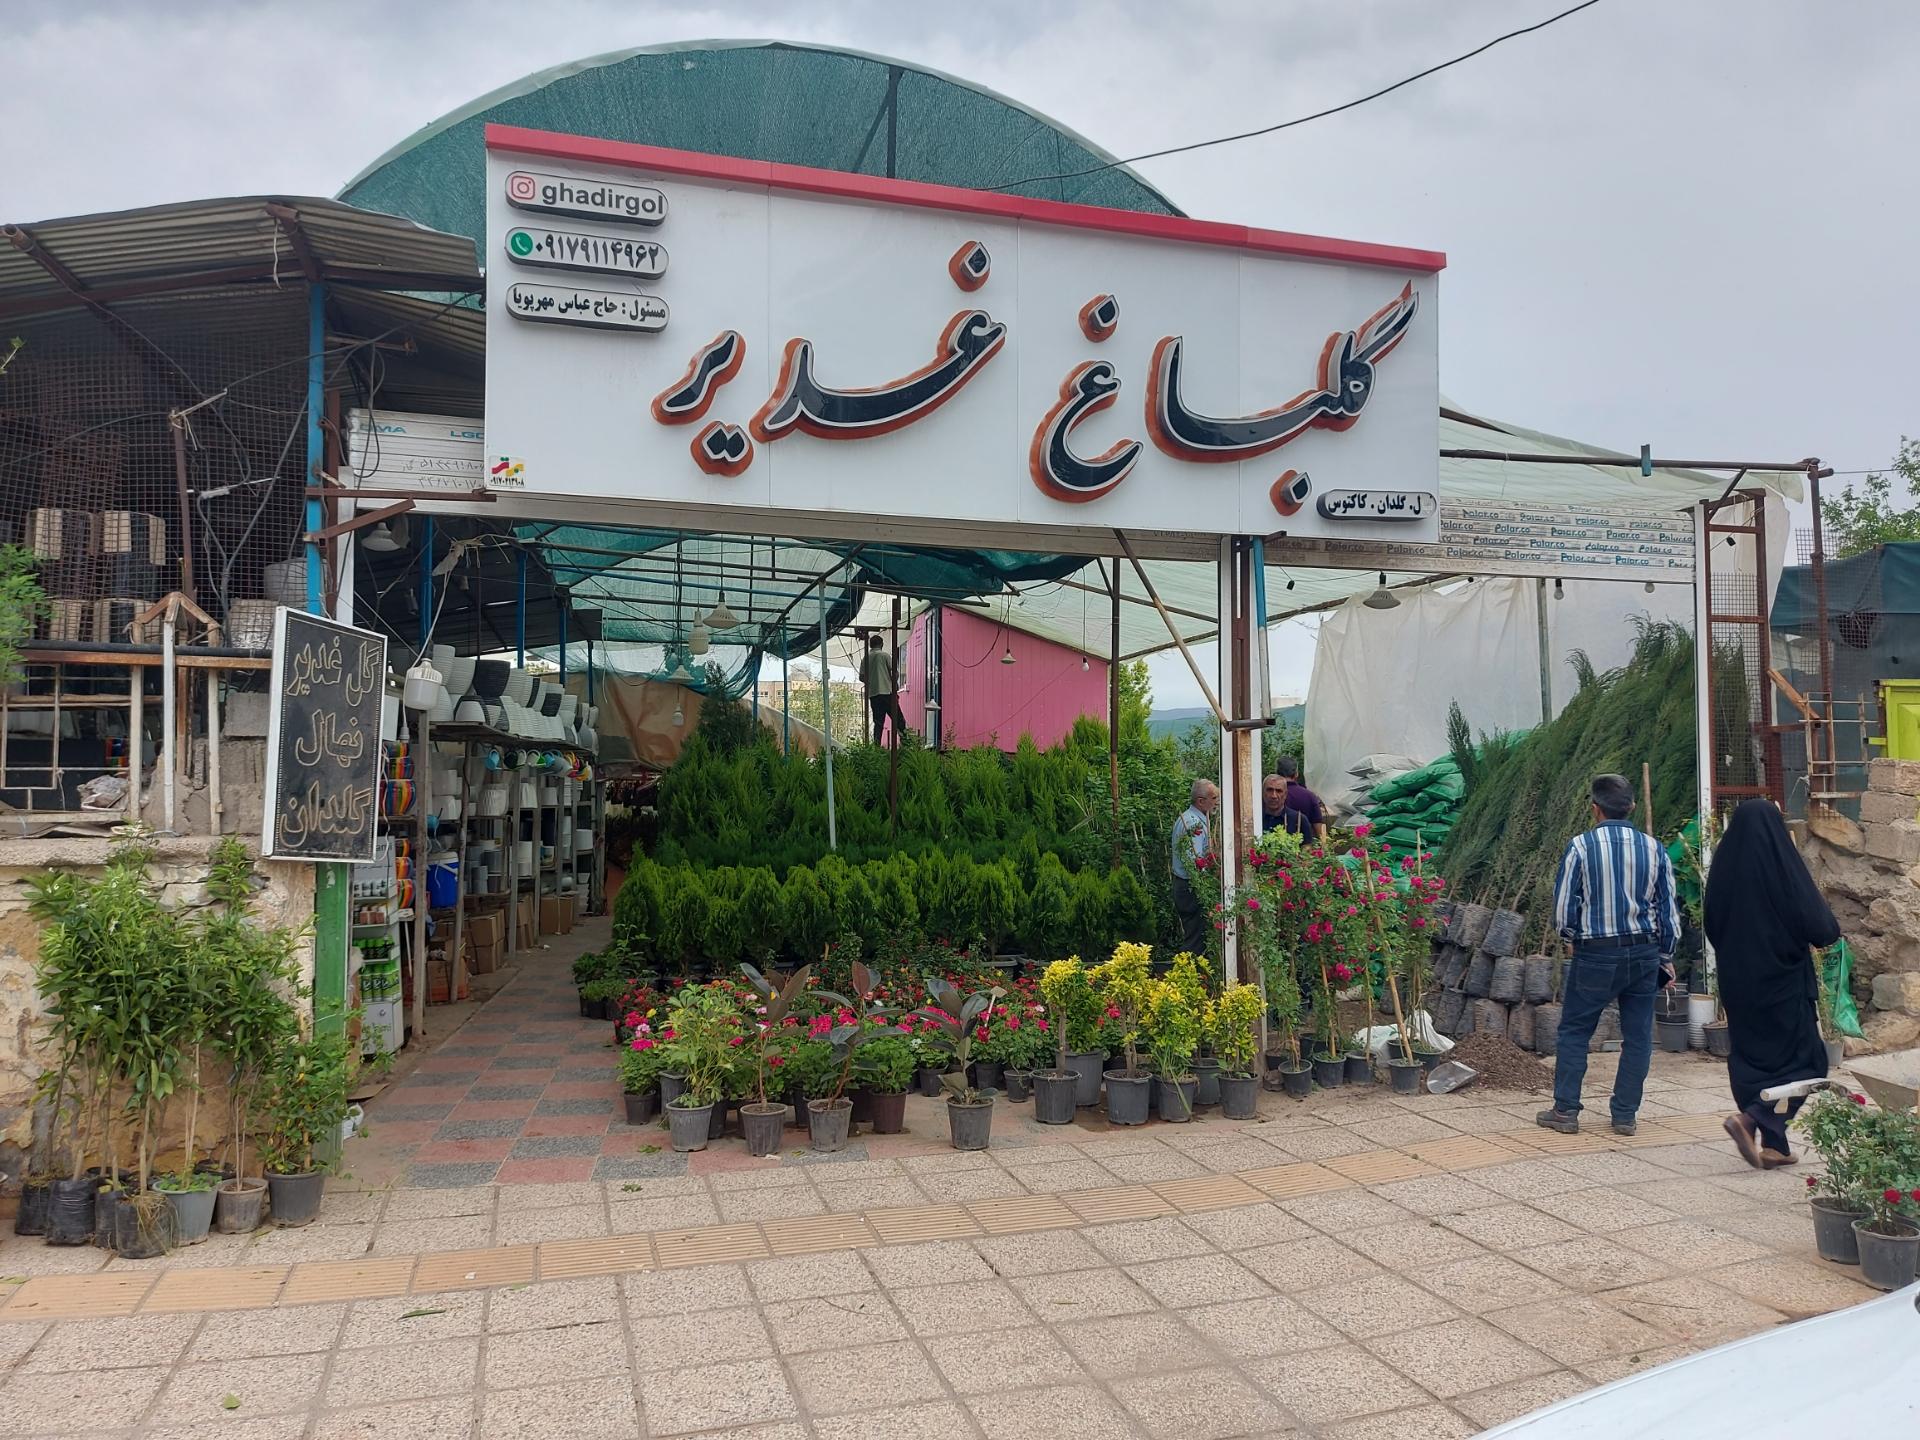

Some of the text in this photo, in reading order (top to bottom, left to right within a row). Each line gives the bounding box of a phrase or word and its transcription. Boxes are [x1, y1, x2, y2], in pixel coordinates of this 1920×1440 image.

[542, 182, 663, 215] ghadirgol
[536, 234, 659, 270] ۰۹۱۷۹۱۱۴۹۶۲
[558, 293, 590, 315] عباس
[594, 297, 618, 317] حاج
[651, 241, 1007, 477] غدیر
[1328, 493, 1367, 514] کاکتوس
[286, 636, 381, 707] گل غدیر
[296, 709, 363, 767] نهال
[280, 780, 371, 848] گلدان
